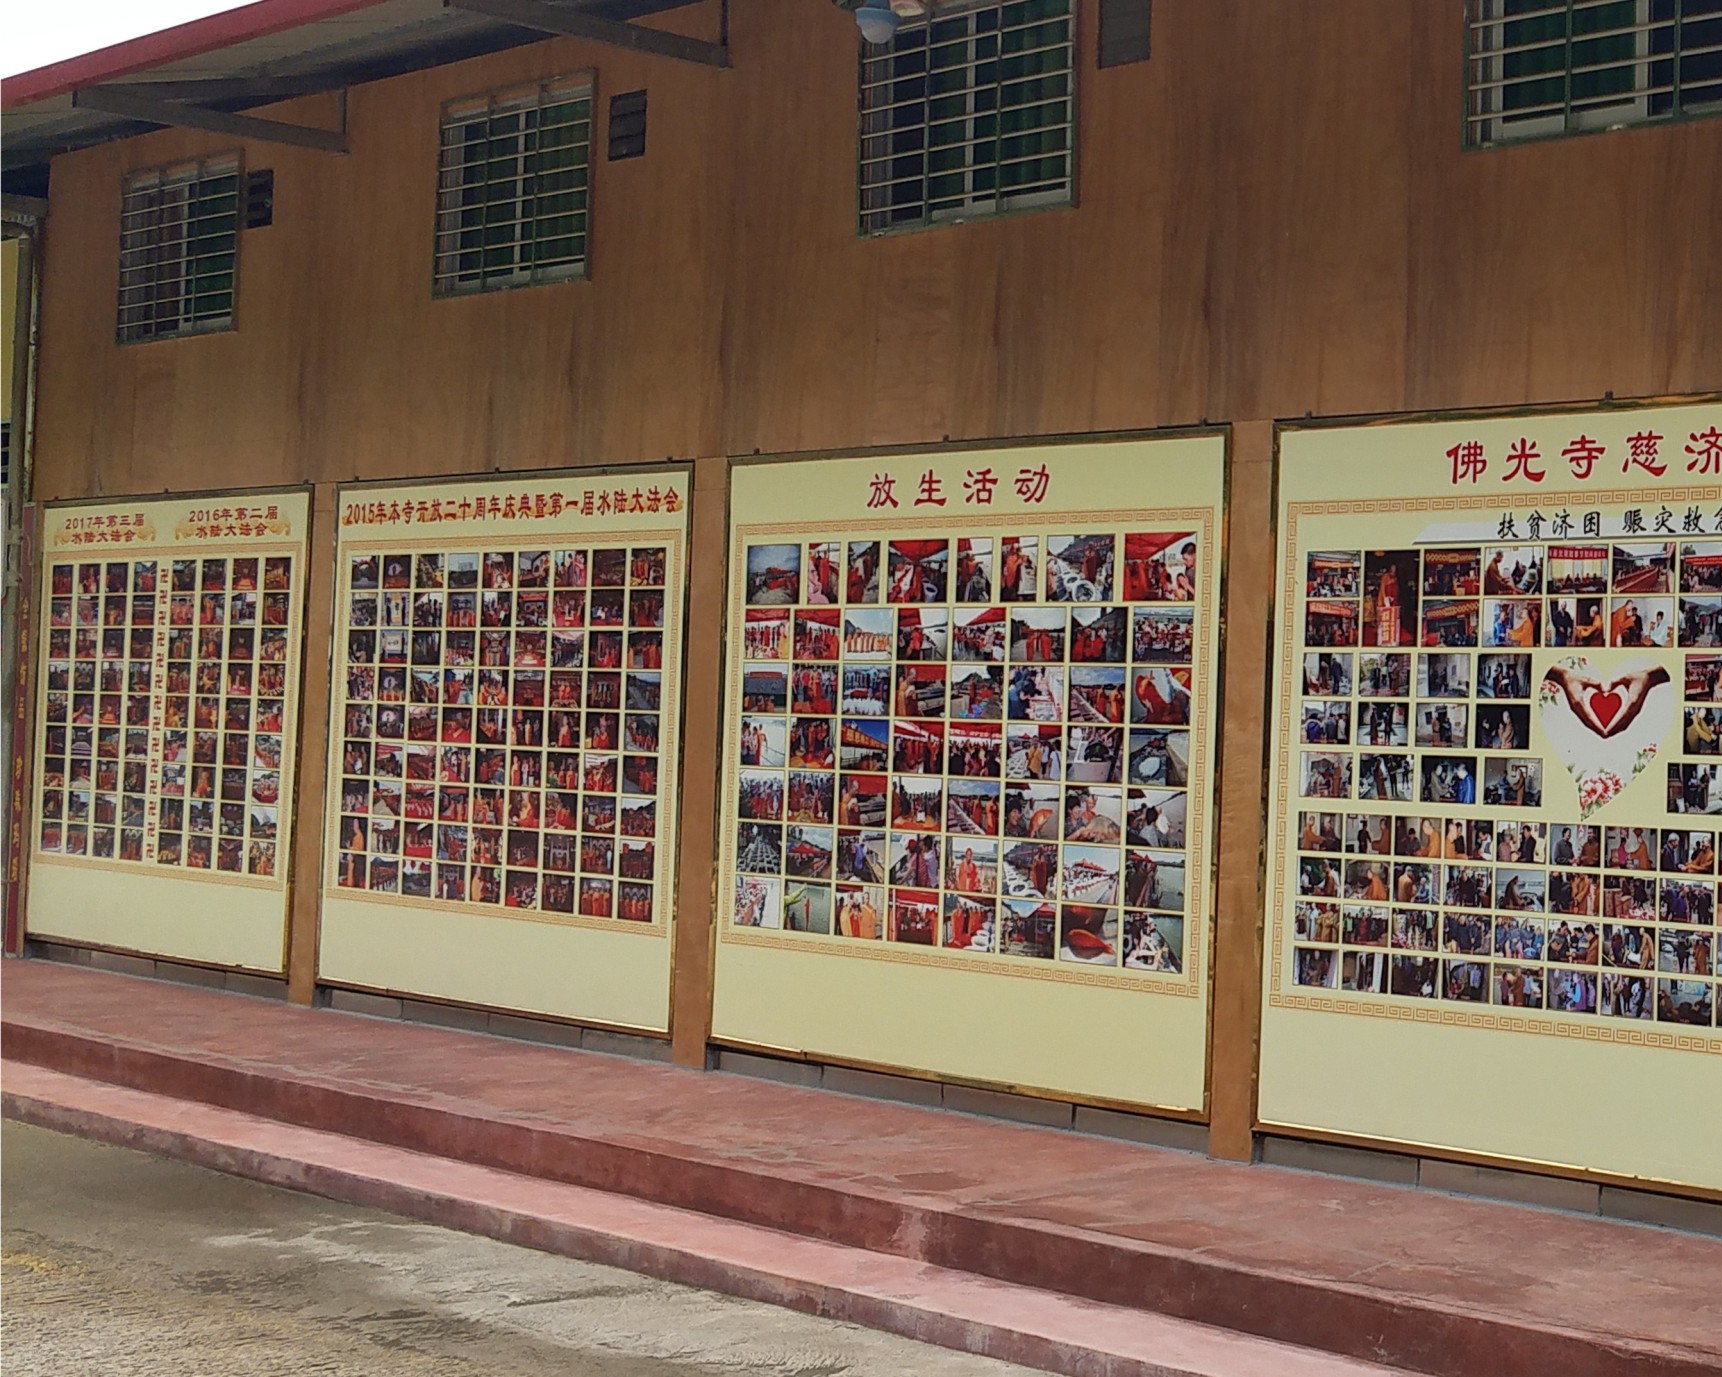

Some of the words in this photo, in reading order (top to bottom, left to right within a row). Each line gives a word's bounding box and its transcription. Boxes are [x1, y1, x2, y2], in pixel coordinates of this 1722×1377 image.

[866, 463, 1051, 509] 放生活动
[65, 513, 145, 530] 2017年第三届
[189, 505, 278, 523] 2016年第二届
[1497, 509, 1601, 540] 扶贫济困
